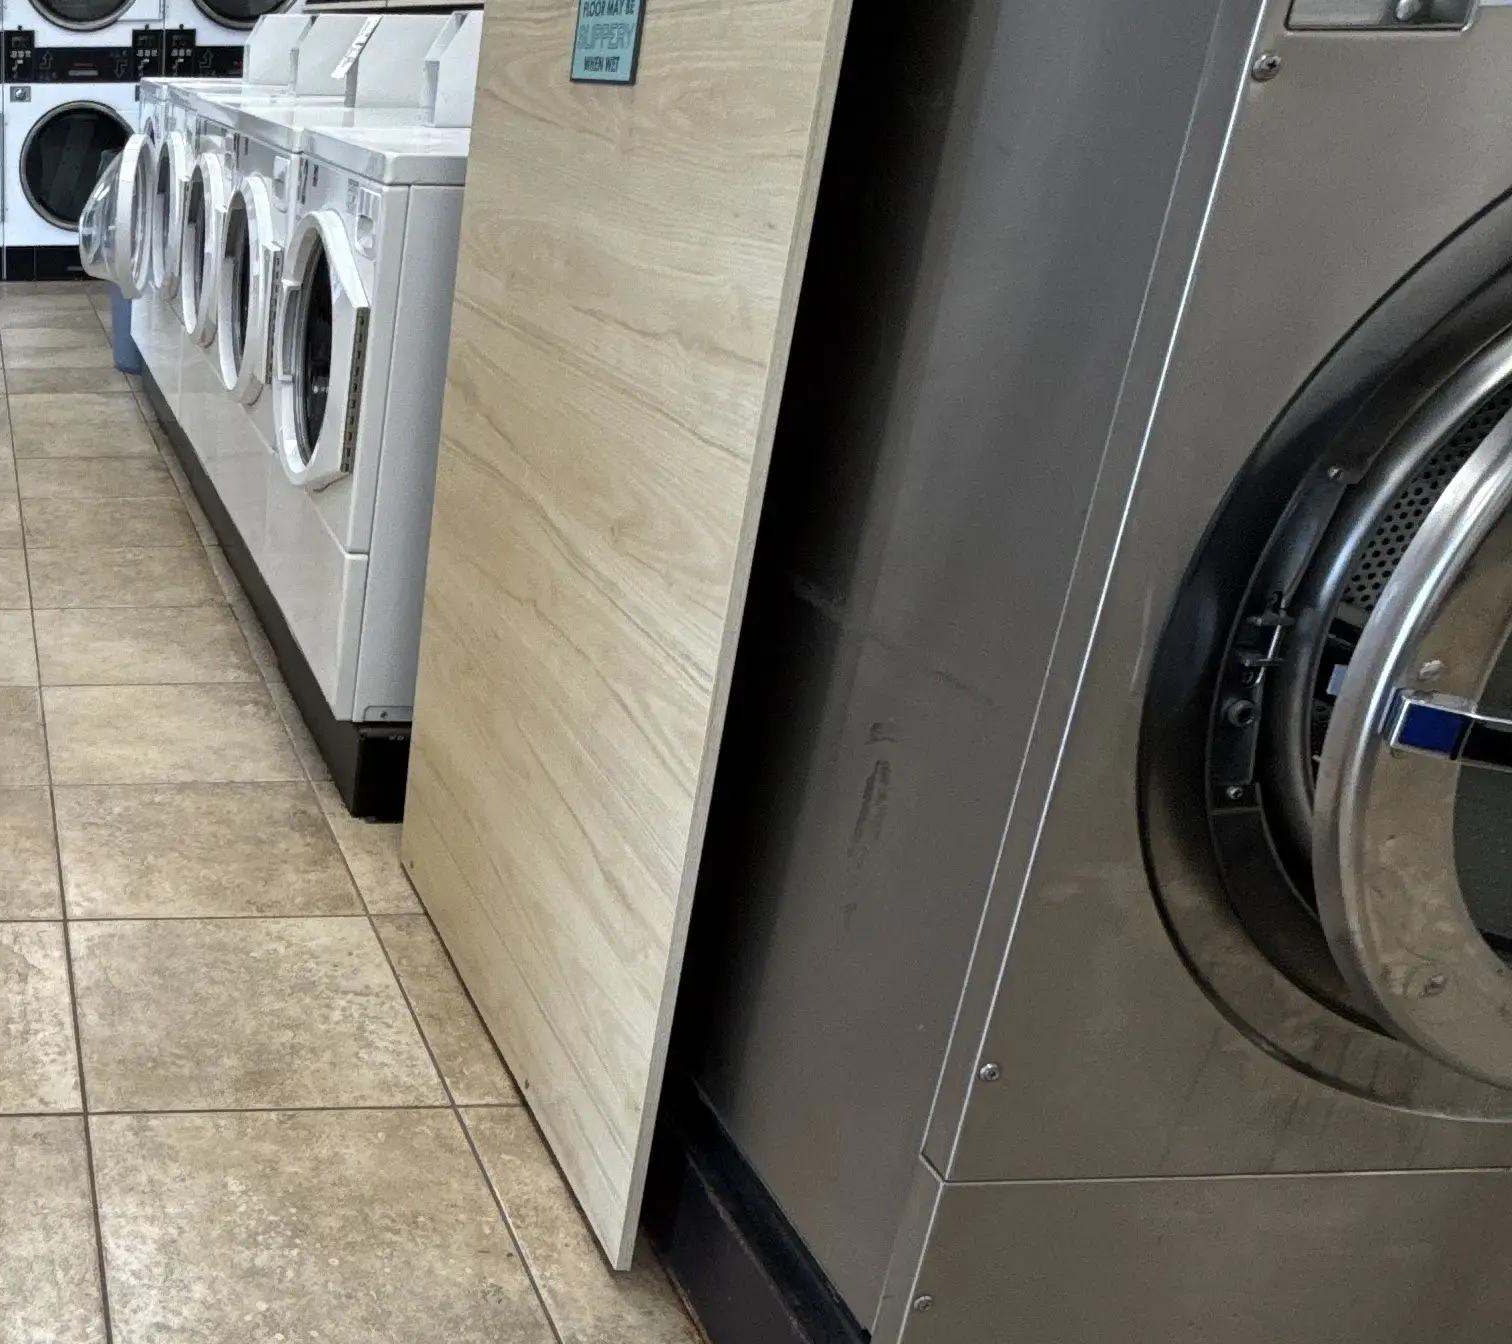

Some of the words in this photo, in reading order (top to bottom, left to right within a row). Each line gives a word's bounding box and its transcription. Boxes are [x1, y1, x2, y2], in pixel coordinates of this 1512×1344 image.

[583, 0, 606, 18] FLOOR
[607, 0, 625, 16] MAY
[579, 22, 635, 50] SLIPPERY
[584, 56, 604, 72] WHEN
[605, 56, 620, 72] WET
